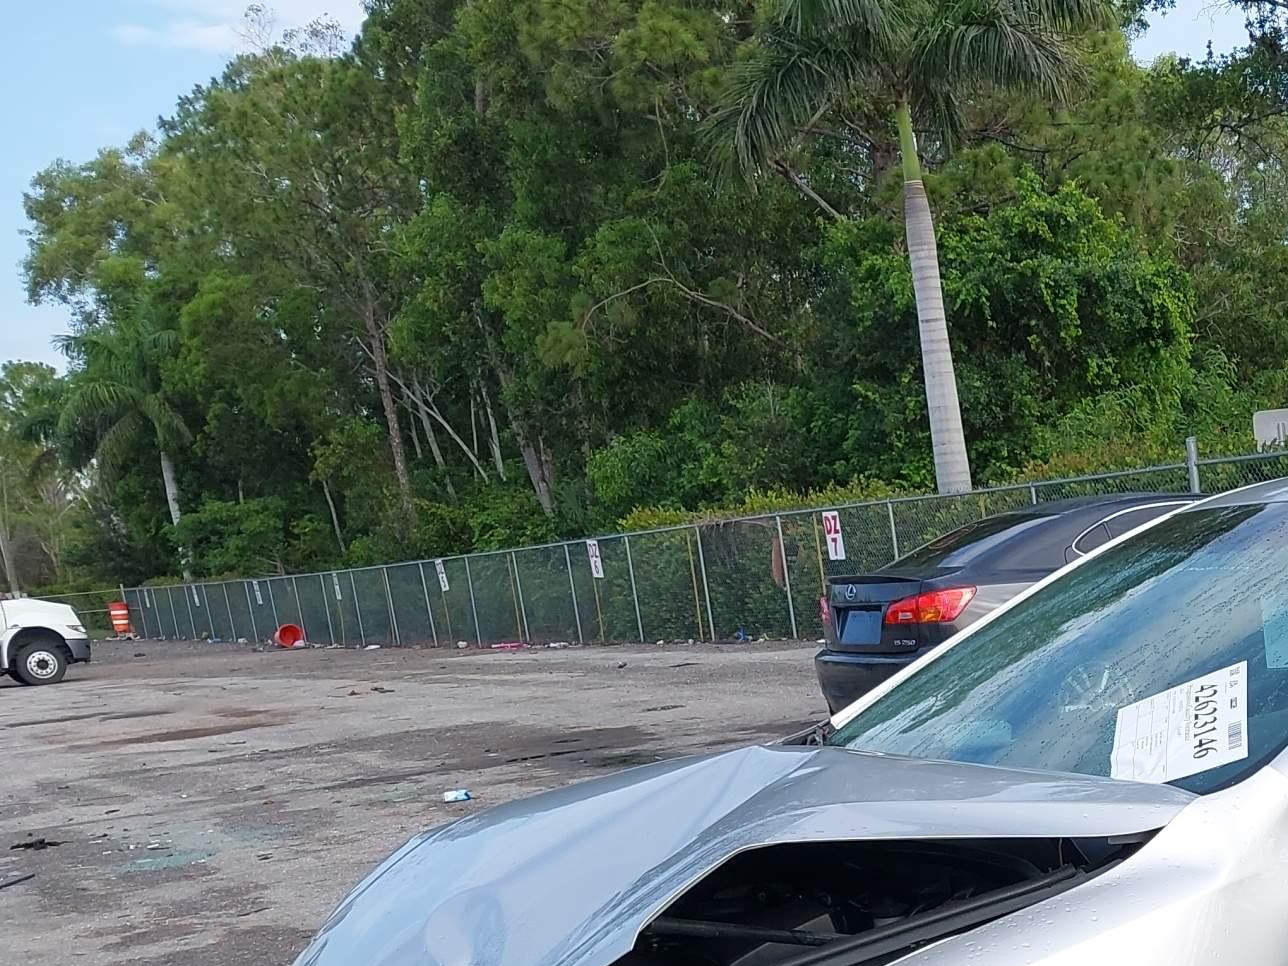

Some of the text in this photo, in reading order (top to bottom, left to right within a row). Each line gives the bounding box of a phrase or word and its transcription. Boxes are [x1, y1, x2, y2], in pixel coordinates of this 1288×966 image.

[824, 515, 840, 535] DZ
[831, 537, 838, 556] 7
[1193, 684, 1218, 760] 42623146
